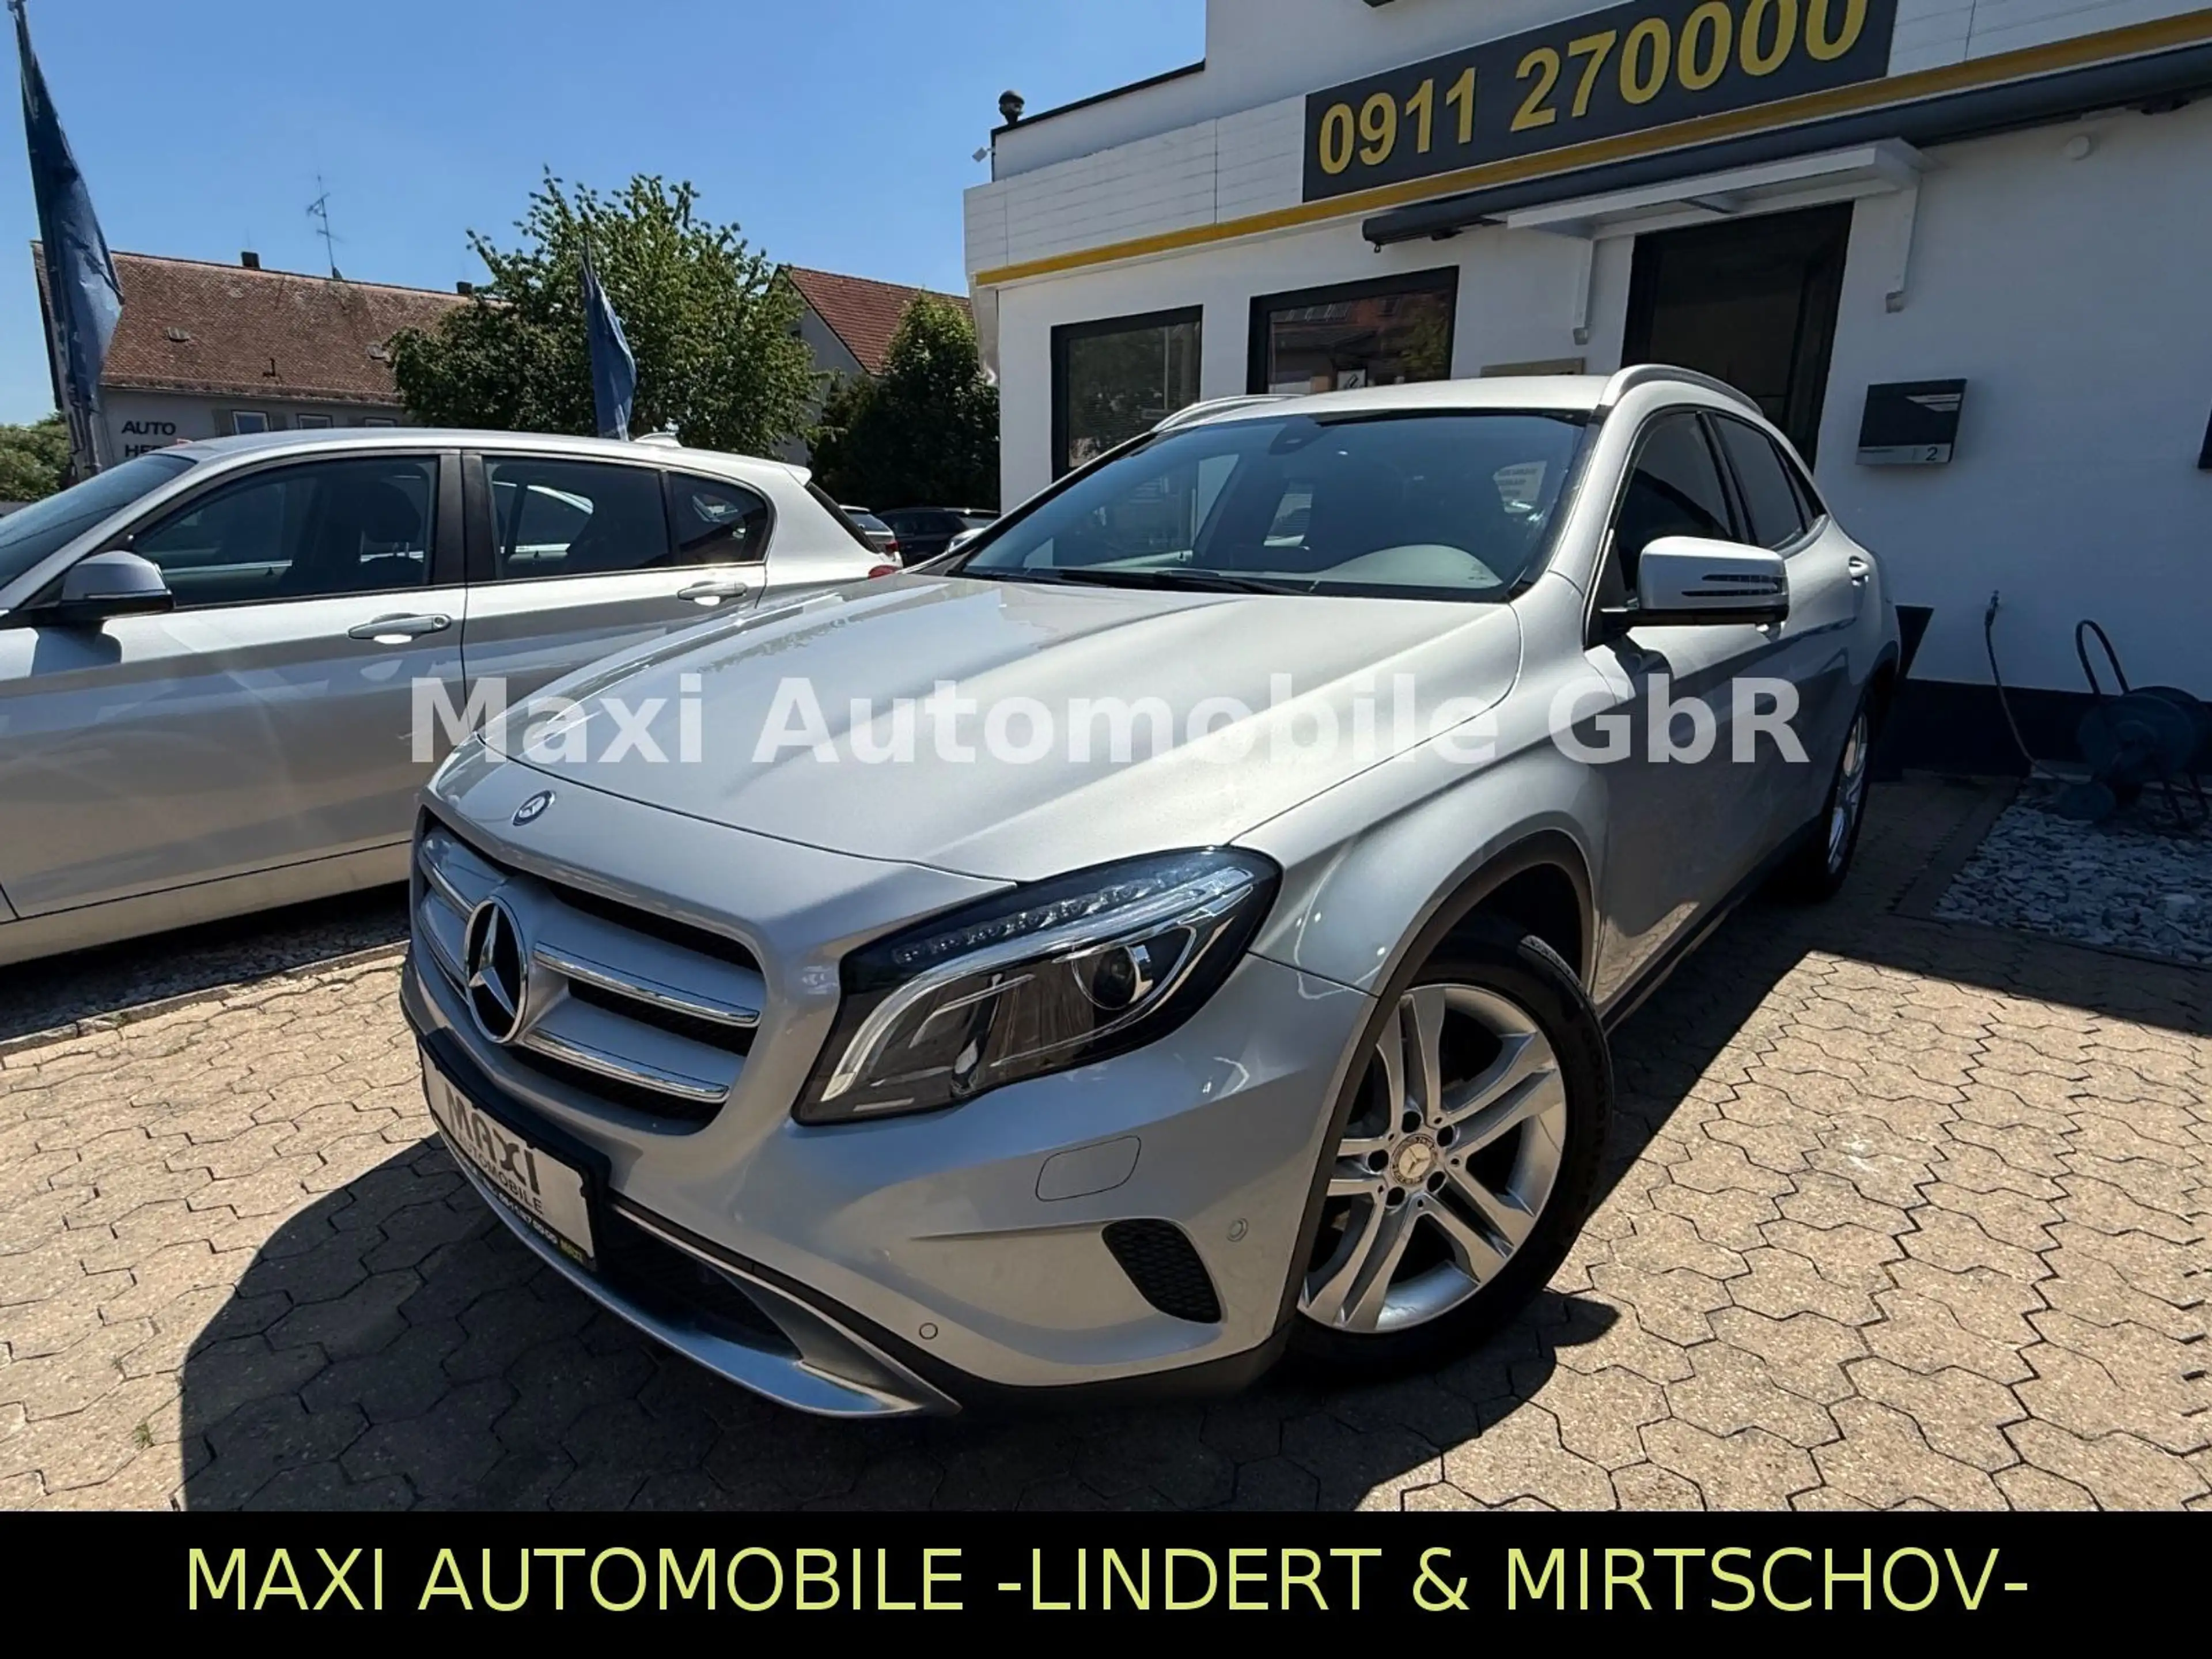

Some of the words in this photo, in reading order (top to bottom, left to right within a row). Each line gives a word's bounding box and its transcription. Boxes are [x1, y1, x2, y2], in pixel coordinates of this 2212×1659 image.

[1318, 67, 1476, 176] 0911
[1509, 0, 1866, 133] 270000
[121, 420, 176, 435] AUTO
[1925, 446, 1938, 461] 2
[445, 1082, 541, 1196] MAXI
